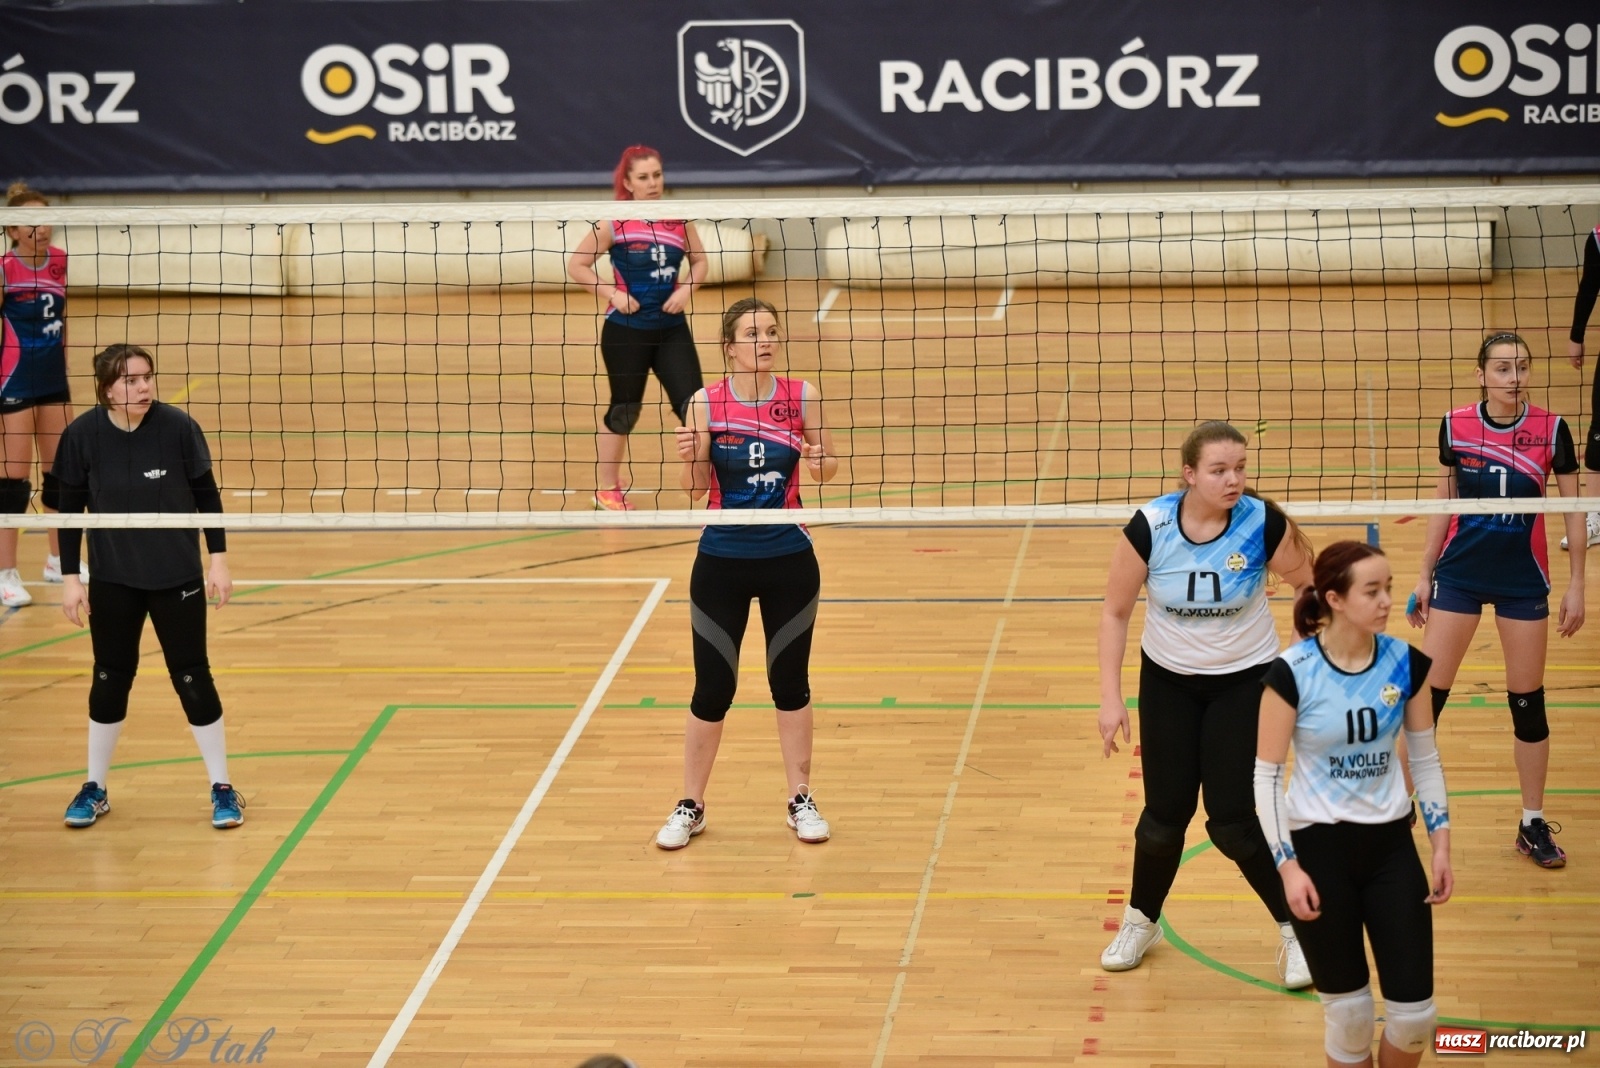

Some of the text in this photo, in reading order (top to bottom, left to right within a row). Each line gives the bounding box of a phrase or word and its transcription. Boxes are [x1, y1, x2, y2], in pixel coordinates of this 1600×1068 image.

[879, 37, 1260, 113] RACIBÓRZ
[1434, 23, 1600, 98] OSi
[388, 115, 517, 142] RACIBÓRZ
[650, 244, 667, 267] 4
[41, 293, 55, 319] 2
[748, 441, 765, 468] 8
[1489, 465, 1507, 497] 7
[1187, 571, 1222, 602] 17
[1346, 707, 1378, 744] 10
[1329, 751, 1391, 768] PV VOLLEY
